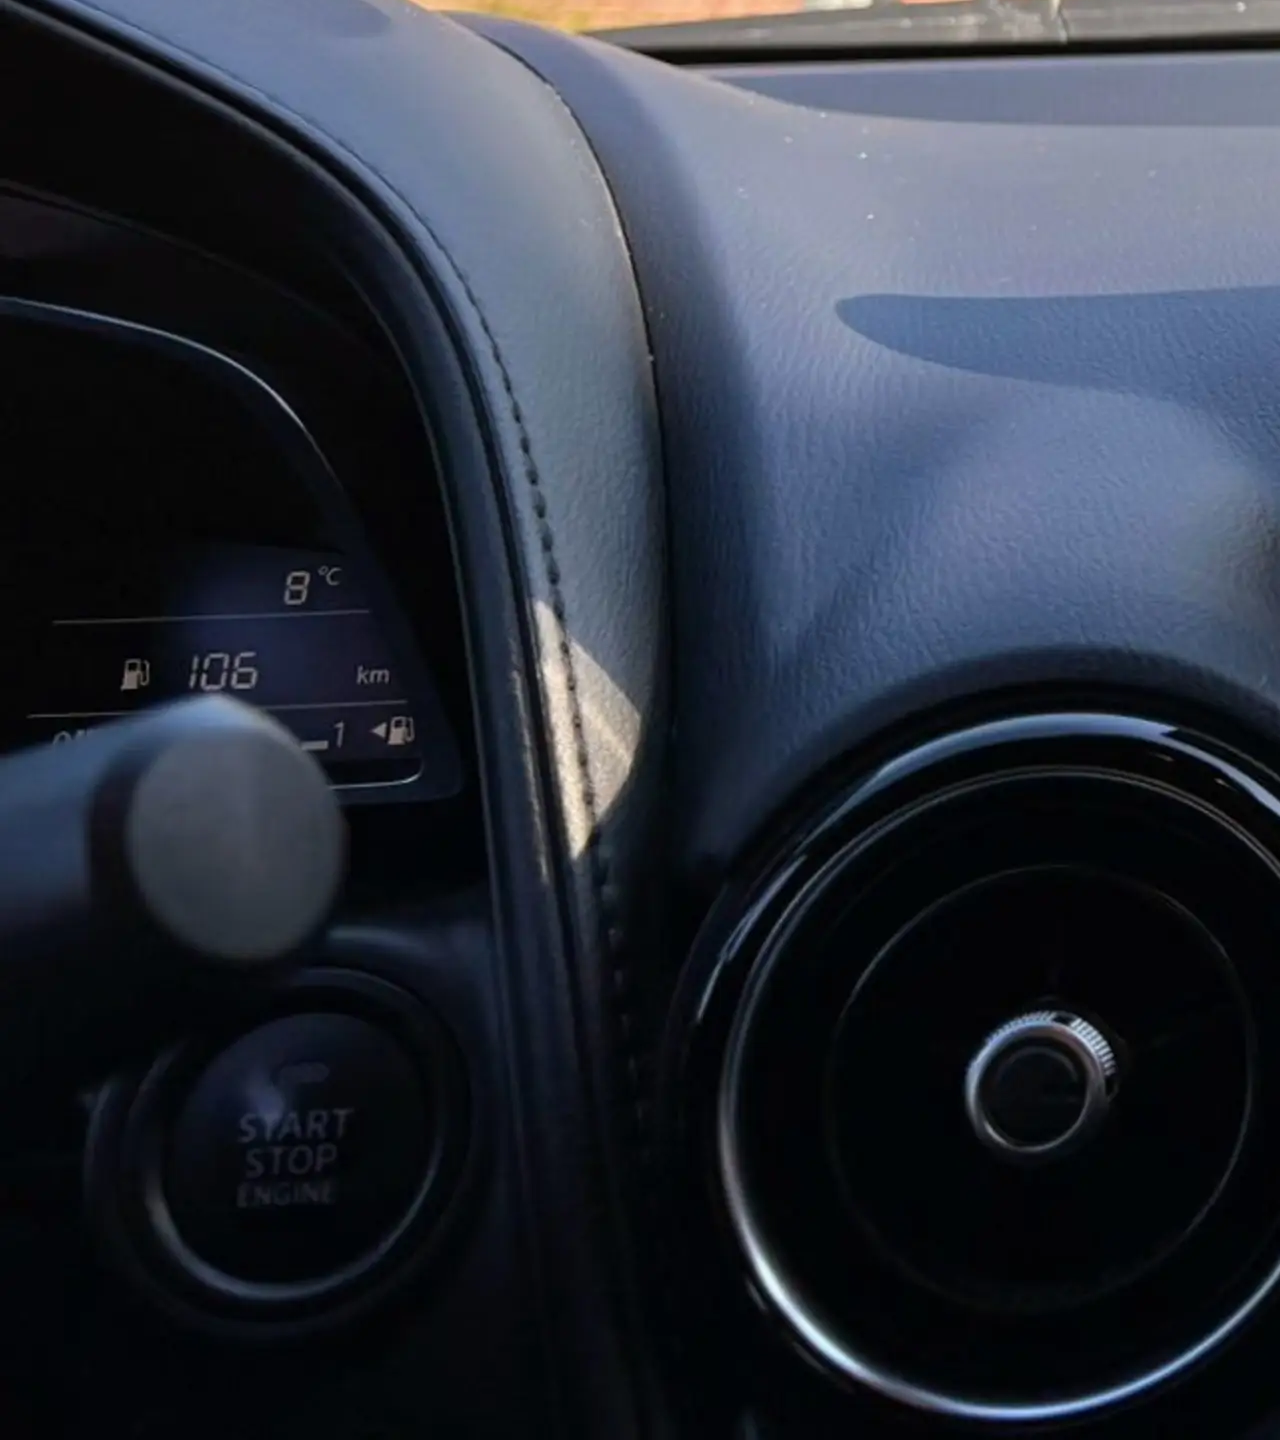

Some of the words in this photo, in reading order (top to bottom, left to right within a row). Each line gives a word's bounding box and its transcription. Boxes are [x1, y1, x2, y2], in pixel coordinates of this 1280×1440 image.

[189, 652, 259, 692] 106
[356, 664, 391, 685] km
[236, 1105, 356, 1144] START
[244, 1141, 339, 1179] STOP
[236, 1179, 335, 1209] ENGINE
